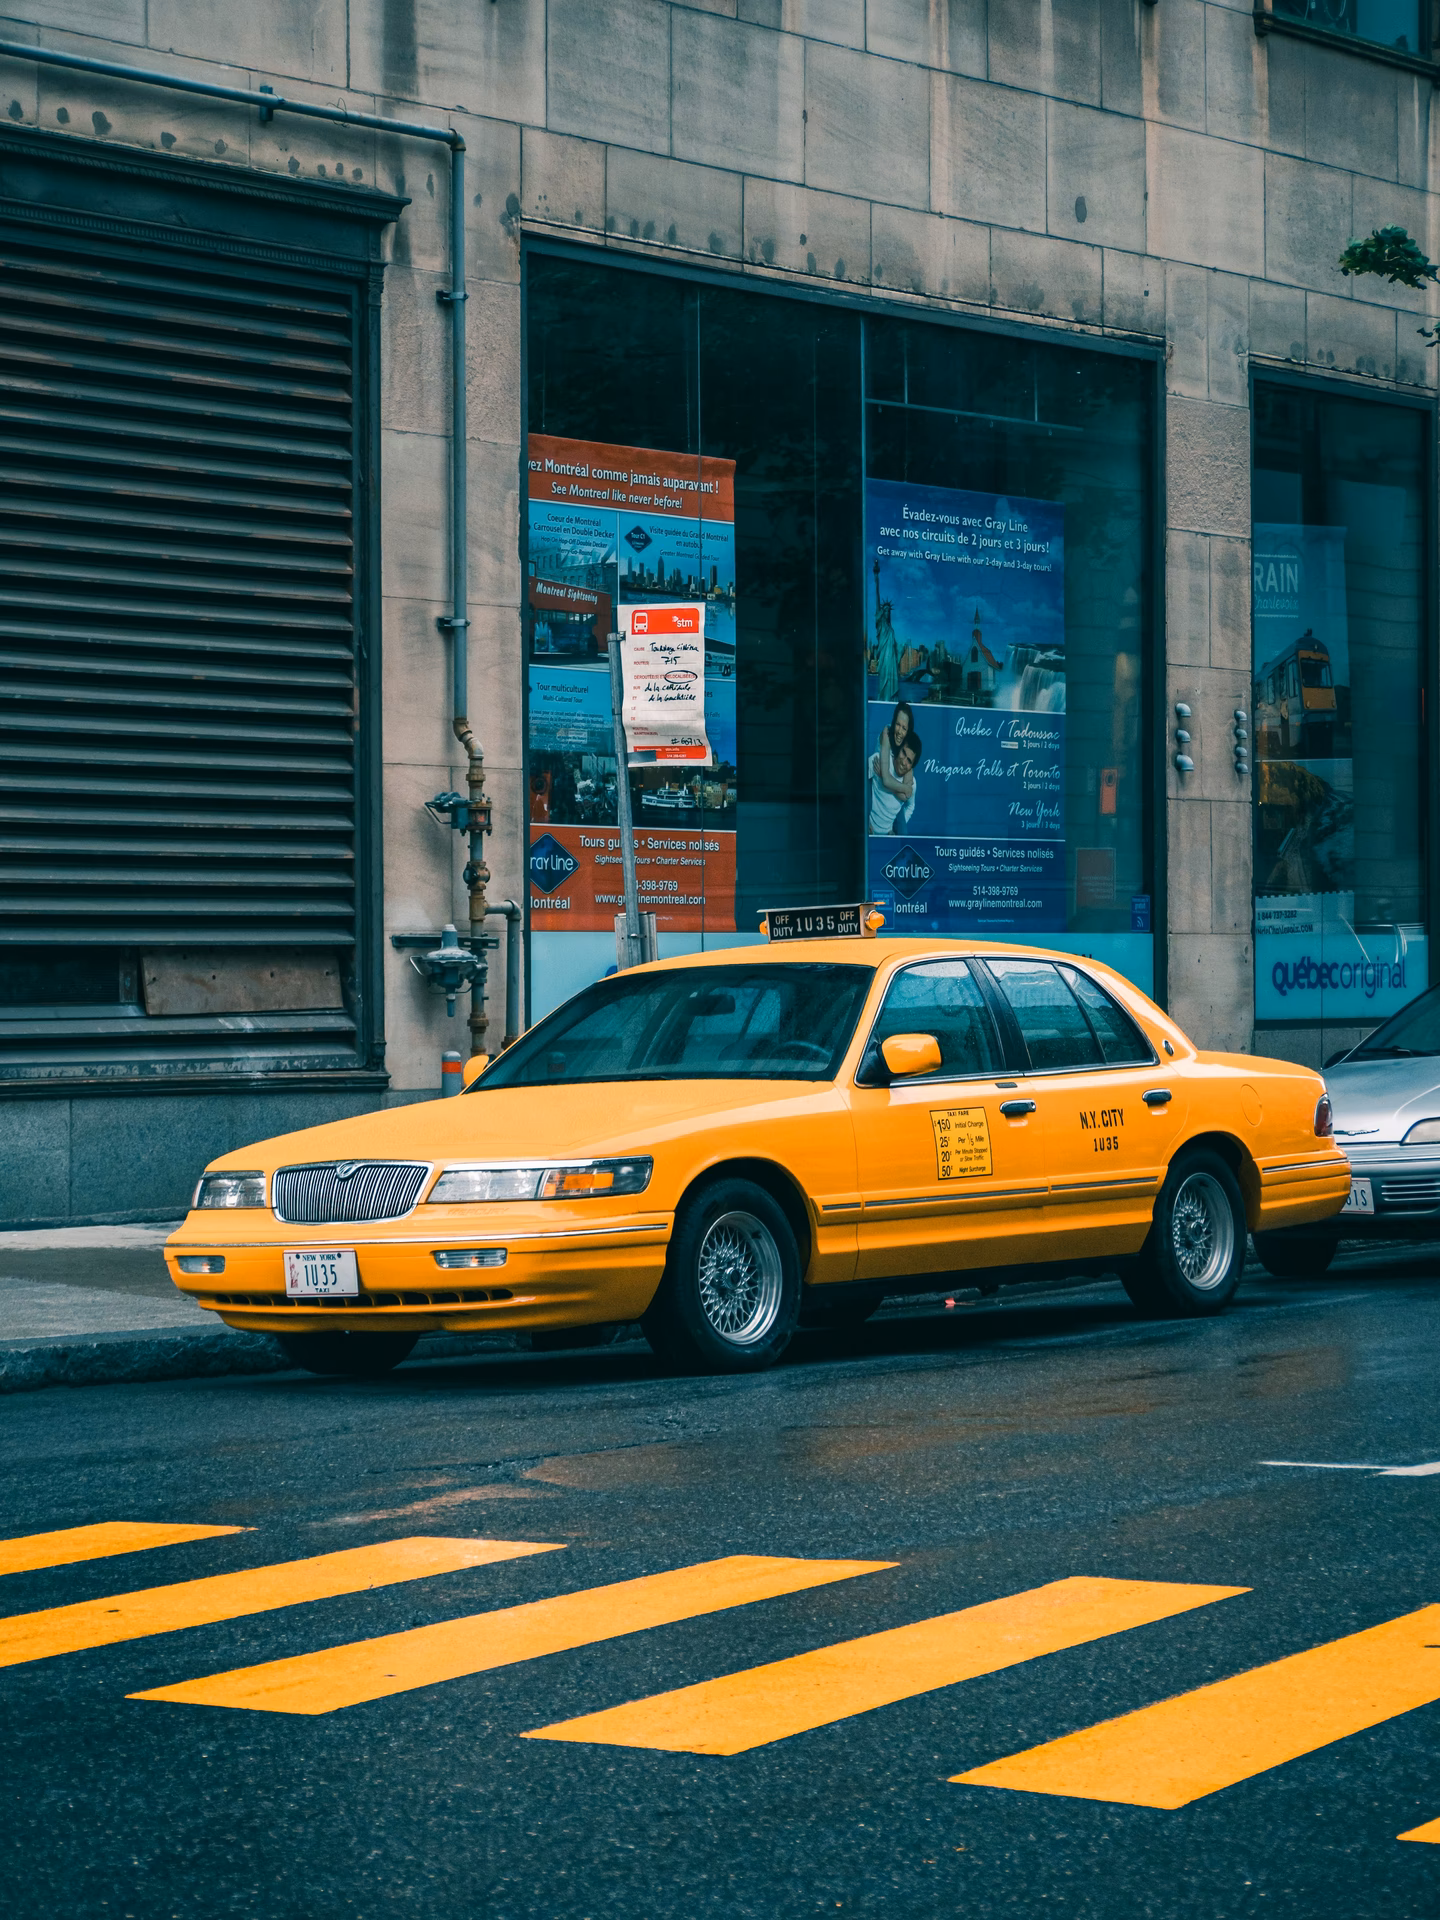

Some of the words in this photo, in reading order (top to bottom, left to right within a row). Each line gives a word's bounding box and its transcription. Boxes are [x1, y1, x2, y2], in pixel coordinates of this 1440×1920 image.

[545, 458, 589, 477] Montréal
[592, 468, 628, 482] comme
[630, 469, 660, 486] jamais
[663, 477, 713, 493] auparavant
[552, 481, 566, 494] See
[569, 484, 610, 499] Montreal
[612, 488, 626, 501] like
[629, 494, 651, 505] never
[654, 494, 682, 509] before!
[547, 513, 565, 523] Coeur
[566, 515, 574, 524] de
[575, 516, 602, 526] Montréal
[903, 504, 959, 525] Évadez-vous
[962, 517, 982, 527] avec
[984, 516, 1006, 533] Gray
[1009, 519, 1028, 532] Line
[534, 522, 562, 533] Carrousel
[572, 527, 593, 537] Double
[594, 529, 615, 539] Decker
[650, 526, 663, 534] Visite
[689, 531, 705, 539] Grad
[706, 533, 728, 542] Montréal
[880, 526, 900, 537] avec
[903, 529, 919, 540] nos
[922, 528, 955, 543] circuits
[957, 532, 969, 545] de
[971, 533, 977, 546] 2
[979, 534, 1002, 549] jours
[1004, 539, 1014, 549] et
[1016, 538, 1021, 550] 3
[1023, 539, 1049, 554] jours!
[877, 545, 890, 555] Get
[891, 549, 907, 559] away
[908, 549, 923, 559] with
[925, 551, 940, 563] Gray
[942, 552, 956, 562] Line
[957, 554, 971, 564] with
[986, 557, 1002, 569] 2-day
[1003, 560, 1015, 568] and
[1016, 560, 1032, 572] 3-day
[1034, 563, 1052, 572] tours!
[1254, 562, 1298, 593] RAIN
[536, 582, 567, 597] Montreal
[567, 588, 598, 605] Sightseeing
[677, 619, 692, 628] stm
[537, 682, 550, 690] Tour
[551, 684, 589, 694] multiculturel
[955, 716, 992, 737] Québec
[1008, 719, 1060, 740] Tadoussac
[1022, 739, 1027, 748] 2
[1027, 740, 1041, 749] jours
[923, 759, 972, 781] Niagara
[975, 758, 1004, 780] Falls
[1007, 761, 1019, 777] et
[1021, 759, 1060, 779] Toronto
[1023, 781, 1027, 789] 2
[1027, 781, 1041, 790] jours
[1008, 801, 1033, 816] New
[1036, 799, 1060, 824] York
[1021, 820, 1025, 828] 3
[1026, 820, 1040, 830] jours
[579, 835, 605, 848] Tours
[647, 837, 686, 850] Services
[935, 846, 957, 857] Tours
[959, 847, 986, 860] guidés
[992, 847, 1025, 858] Services
[1027, 848, 1054, 859] nolisés
[656, 856, 679, 865] Charter
[680, 857, 706, 866] Services
[948, 863, 980, 873] Sightseeing
[980, 864, 995, 872] Tours
[999, 864, 1019, 872] Charter
[1020, 864, 1043, 873] Services
[973, 885, 1018, 896] 514-398-9769
[530, 895, 571, 909] ontréal
[893, 901, 928, 913] ontréal
[948, 898, 1043, 910] www.graylinemontreal.com
[775, 915, 789, 925] OFF
[840, 911, 854, 921] OFF
[773, 926, 793, 937] DUTY
[838, 922, 859, 933] DUTY
[955, 1121, 966, 1129] Initial
[967, 1120, 984, 1129] Charge
[958, 1136, 966, 1144] Per
[1094, 1136, 1119, 1152] 1U35
[304, 1264, 338, 1287] 1U35
